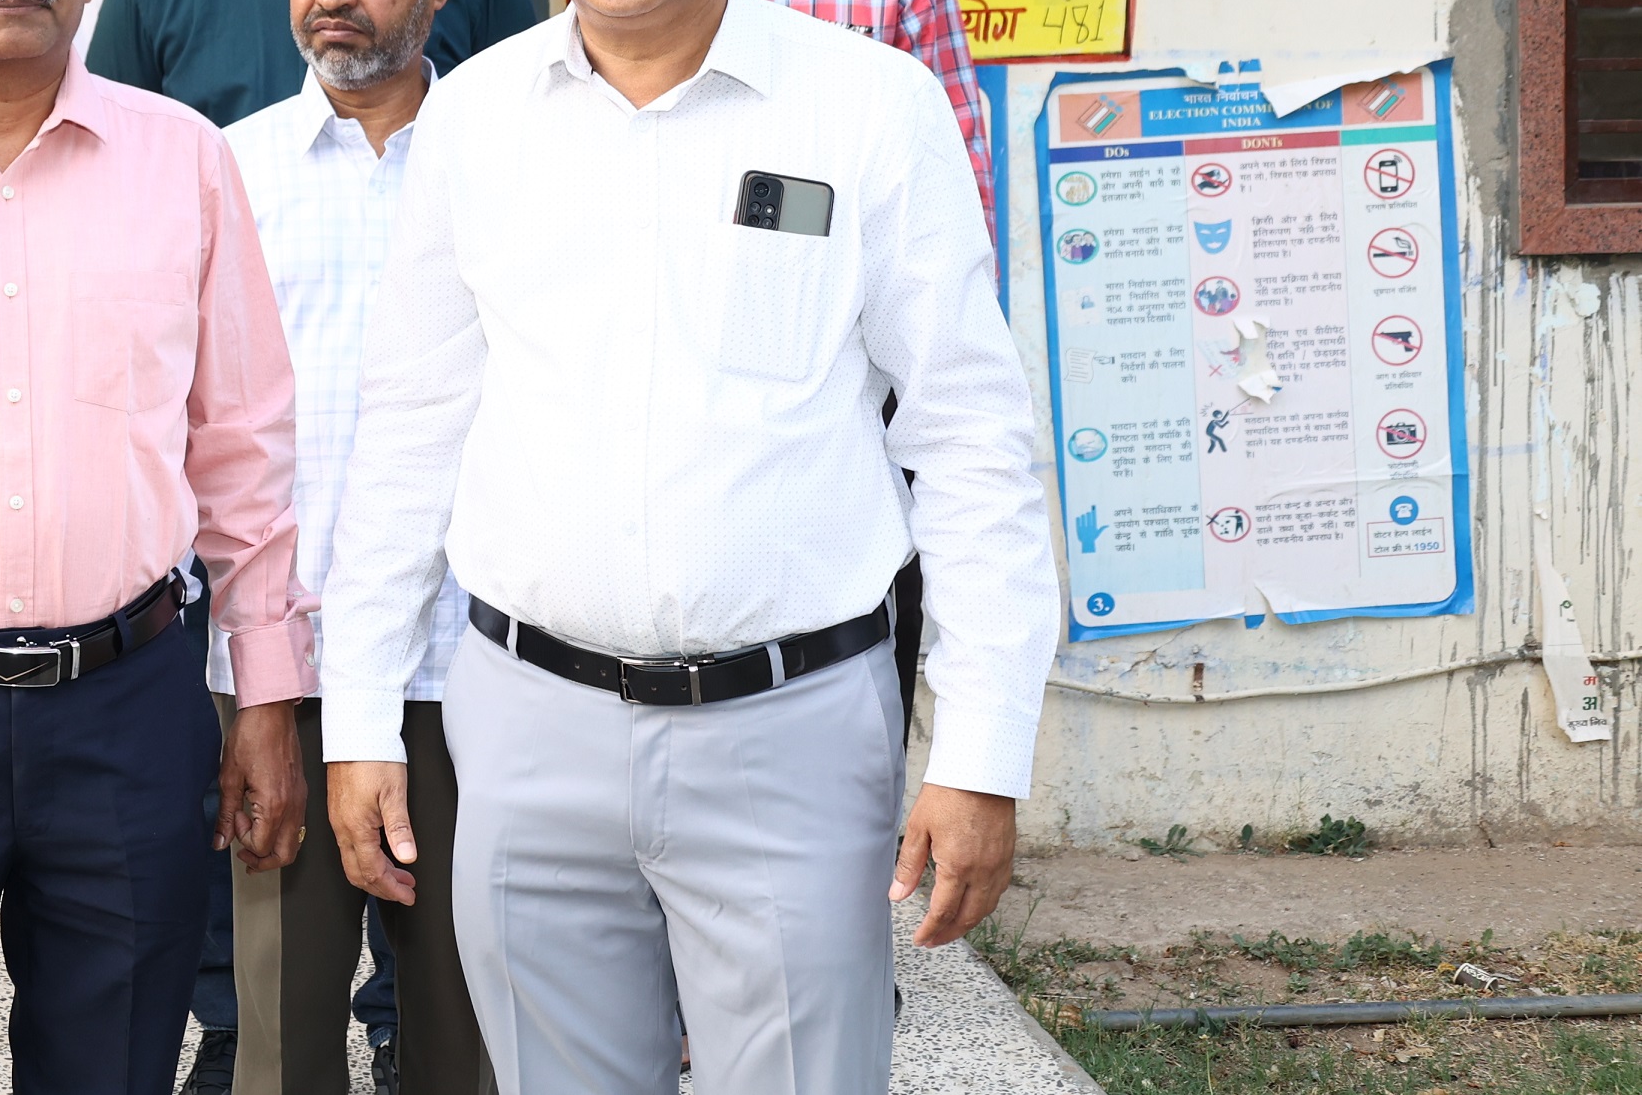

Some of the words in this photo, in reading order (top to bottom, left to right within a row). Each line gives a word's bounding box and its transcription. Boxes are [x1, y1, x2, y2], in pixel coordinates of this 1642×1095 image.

[1183, 94, 1212, 104] भारत
[1148, 108, 1219, 121] ELECTION
[1222, 118, 1262, 129] INDIA
[1242, 137, 1283, 150] DONTs
[1104, 147, 1130, 158] DOs
